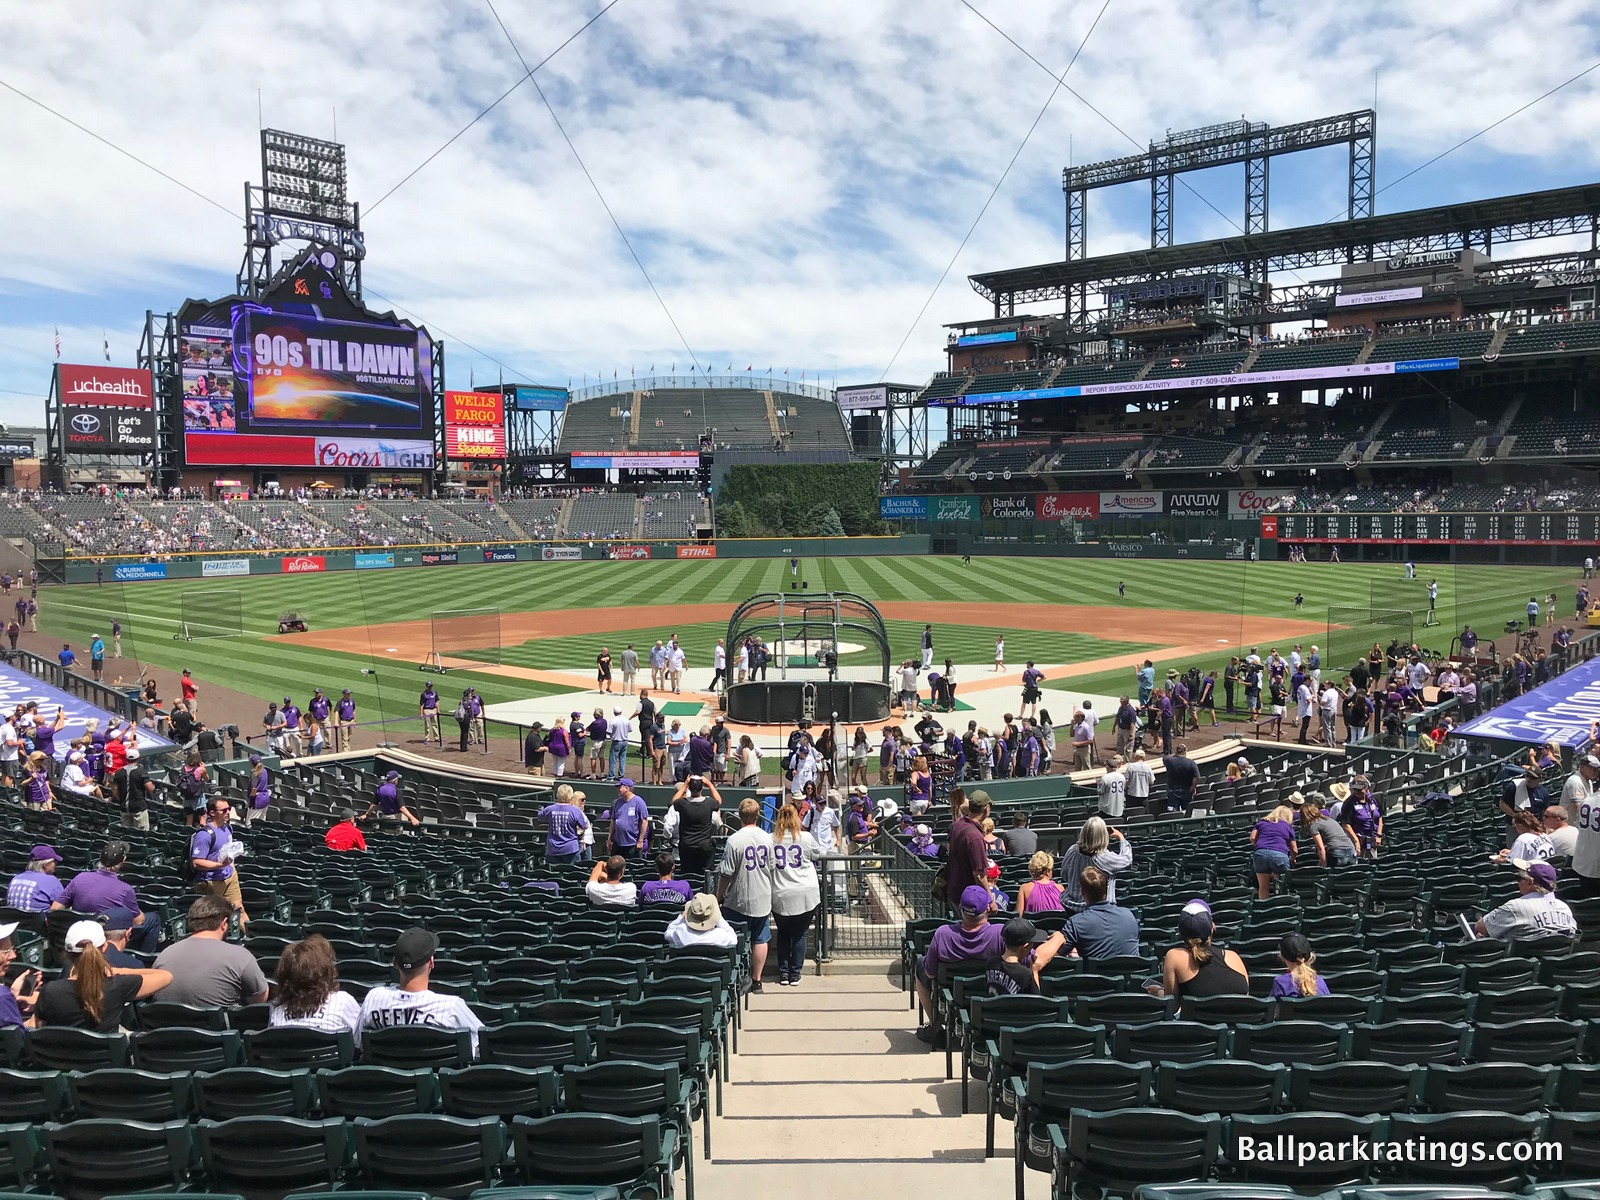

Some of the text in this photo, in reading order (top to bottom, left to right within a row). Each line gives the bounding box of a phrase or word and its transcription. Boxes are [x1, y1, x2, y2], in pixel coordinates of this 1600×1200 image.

[254, 214, 366, 260] ROCKIES
[1404, 254, 1424, 265] JACK
[1557, 274, 1595, 286] Silver
[254, 333, 414, 377] 90s TIL DAWN
[73, 376, 141, 395] uchealth
[355, 374, 416, 386] 90STILDAWN.COM
[1085, 386, 1105, 394] REPORT
[1108, 384, 1144, 393] SUSPICIOUS
[1144, 381, 1171, 390] ACTIVITY
[1190, 376, 1237, 386] 877-509-CIAC
[453, 395, 496, 408] WELLS
[118, 416, 142, 425] Let's
[455, 409, 496, 422] FARGO
[118, 425, 132, 434] Go
[457, 428, 495, 443] KING
[69, 434, 105, 442] TOYOTA
[119, 435, 152, 444] Places
[318, 443, 382, 467] Coors
[457, 442, 496, 457] Soopers
[886, 499, 920, 507] BACHUS &
[938, 496, 968, 509] Comfort
[993, 496, 1026, 508] Bank of
[1170, 494, 1220, 506] ARROW
[1238, 490, 1281, 509] Coo
[880, 506, 913, 514] SCHANKER
[936, 505, 971, 520] dental
[993, 507, 1035, 518] Colorado
[1247, 510, 1263, 519] LIG
[493, 552, 516, 560] Fanatics
[680, 548, 711, 556] STIHL
[288, 561, 320, 572] Red Robin
[1111, 780, 1124, 793] 93
[1579, 803, 1600, 832] 93
[745, 845, 767, 871] 93
[774, 844, 802, 870] 93
